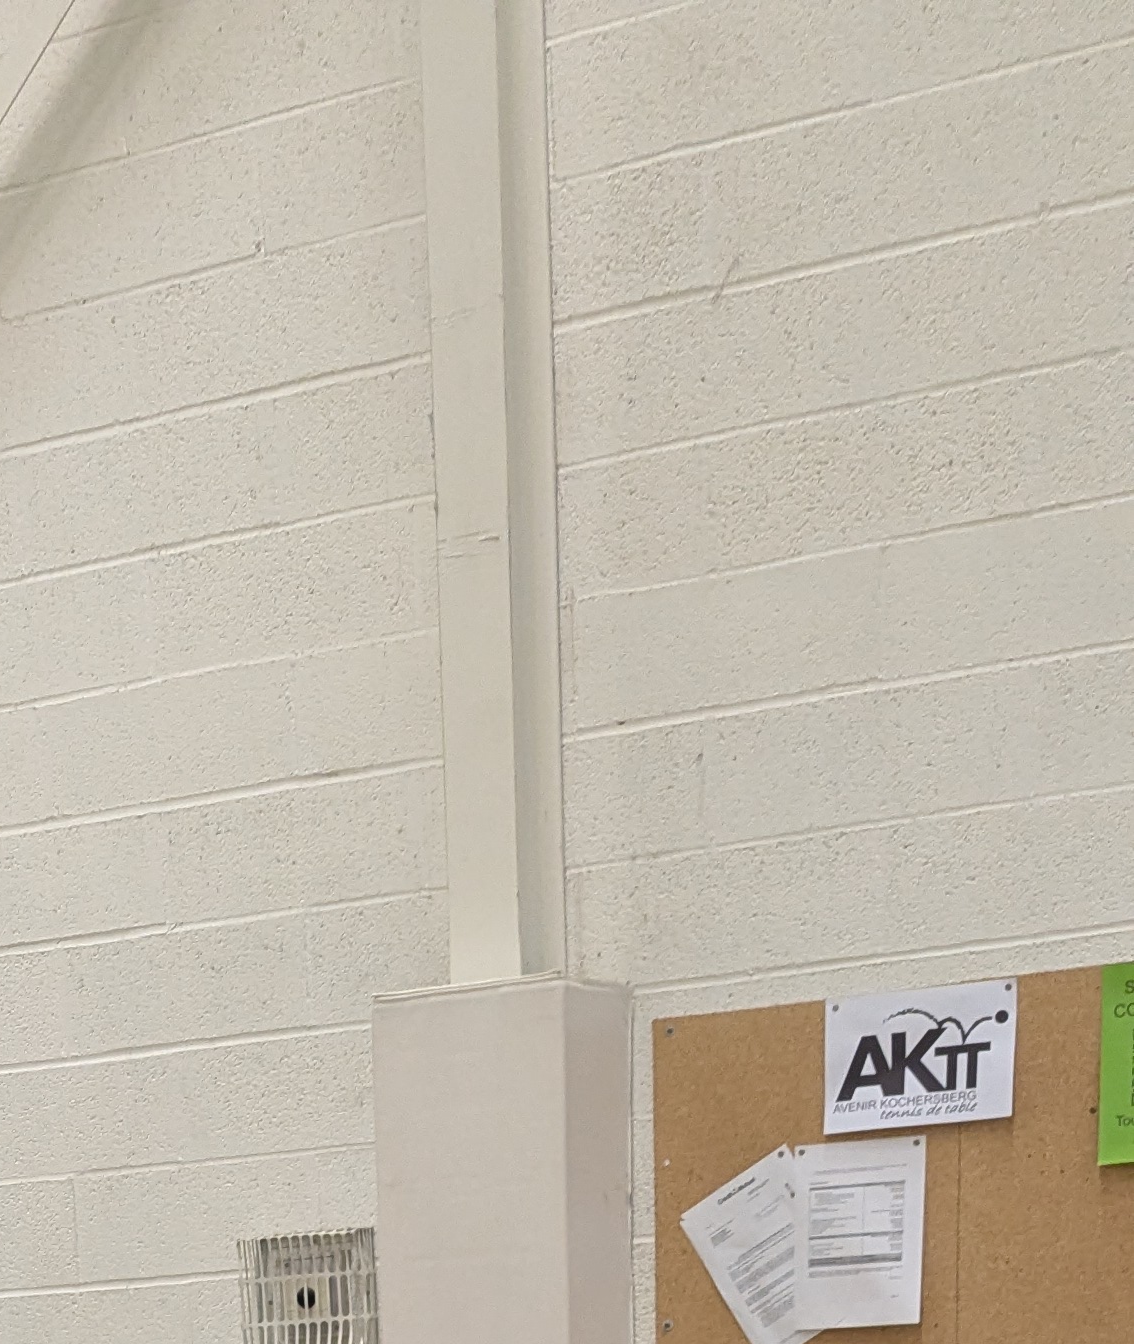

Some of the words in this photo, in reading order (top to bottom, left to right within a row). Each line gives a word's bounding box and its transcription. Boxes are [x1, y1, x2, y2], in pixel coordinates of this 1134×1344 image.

[832, 1100, 877, 1115] AVENIR
[879, 1089, 978, 1110] KOCHERSBERG
[879, 1107, 922, 1120] tennis
[926, 1102, 941, 1116] de
[944, 1101, 978, 1114] table
